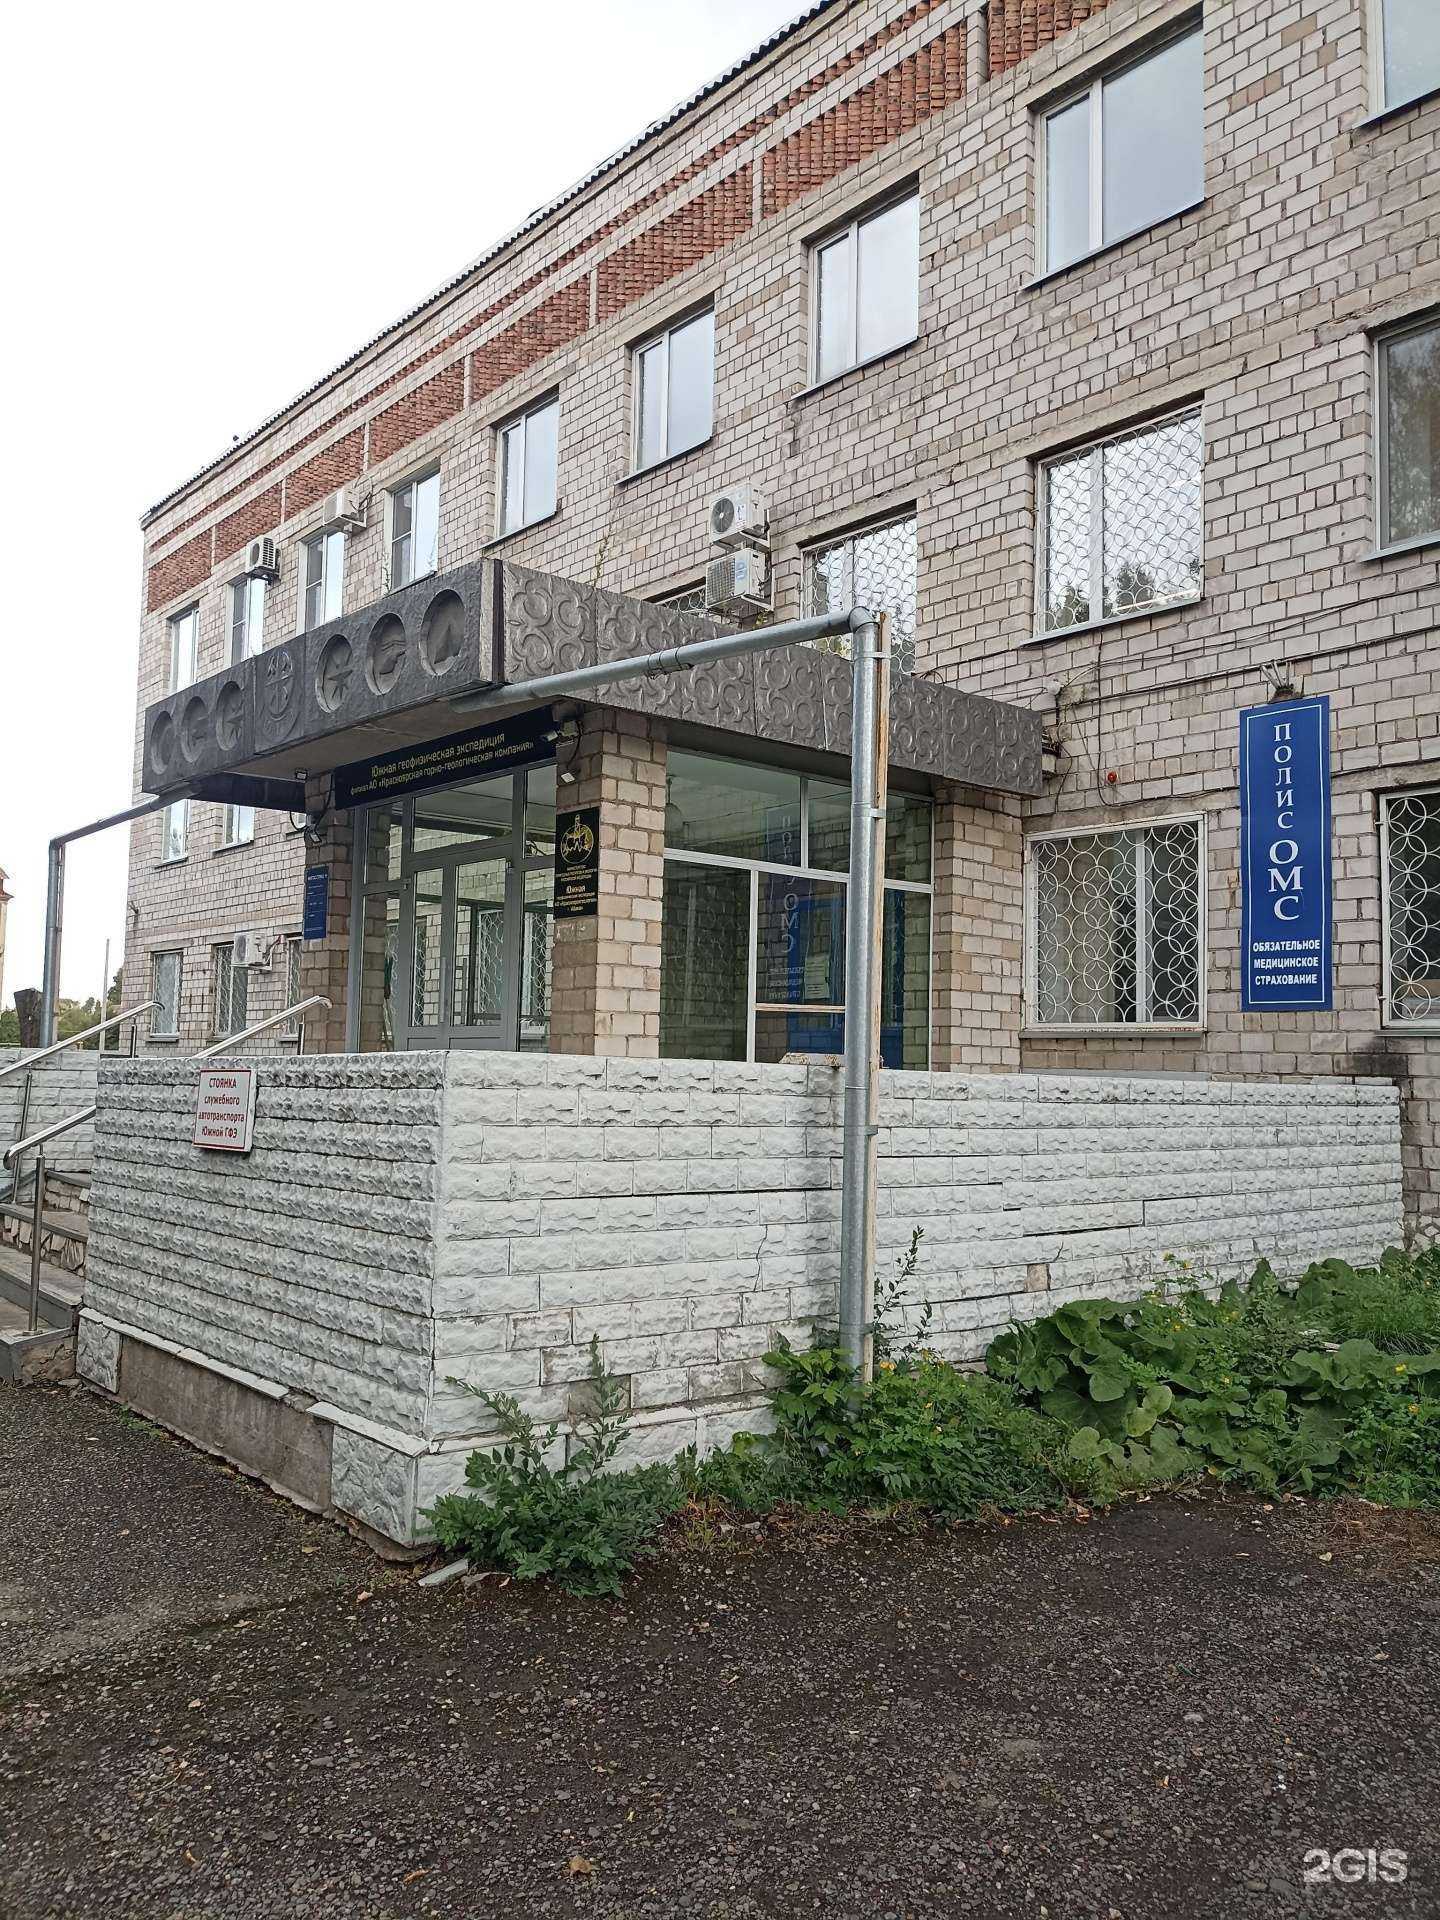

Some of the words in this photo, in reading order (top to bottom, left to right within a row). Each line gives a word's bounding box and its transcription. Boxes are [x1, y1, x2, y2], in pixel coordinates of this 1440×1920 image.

[371, 763, 397, 777] Южная
[398, 746, 455, 770] геофизическая
[456, 733, 505, 756] экспедиция
[369, 779, 378, 790] АО
[378, 769, 423, 788] «Красноярская
[424, 751, 493, 776] горно-геологическая
[494, 741, 534, 757] компания»
[1273, 722, 1294, 830] ПОЛИС
[1268, 839, 1304, 921] ОМС
[1253, 939, 1321, 952] ОБЯЗАТЕЛЬНОЕ
[1253, 956, 1319, 969] МЕДИЦИНСКОЕ
[1255, 973, 1318, 986] СТРАХОВАНИЕ
[209, 1078, 237, 1088] СТОЯНКА
[204, 1094, 240, 1106] служебного
[198, 1112, 245, 1123] автотранспорта
[201, 1125, 224, 1137] Южной
[225, 1127, 237, 1139] ГФЭ
